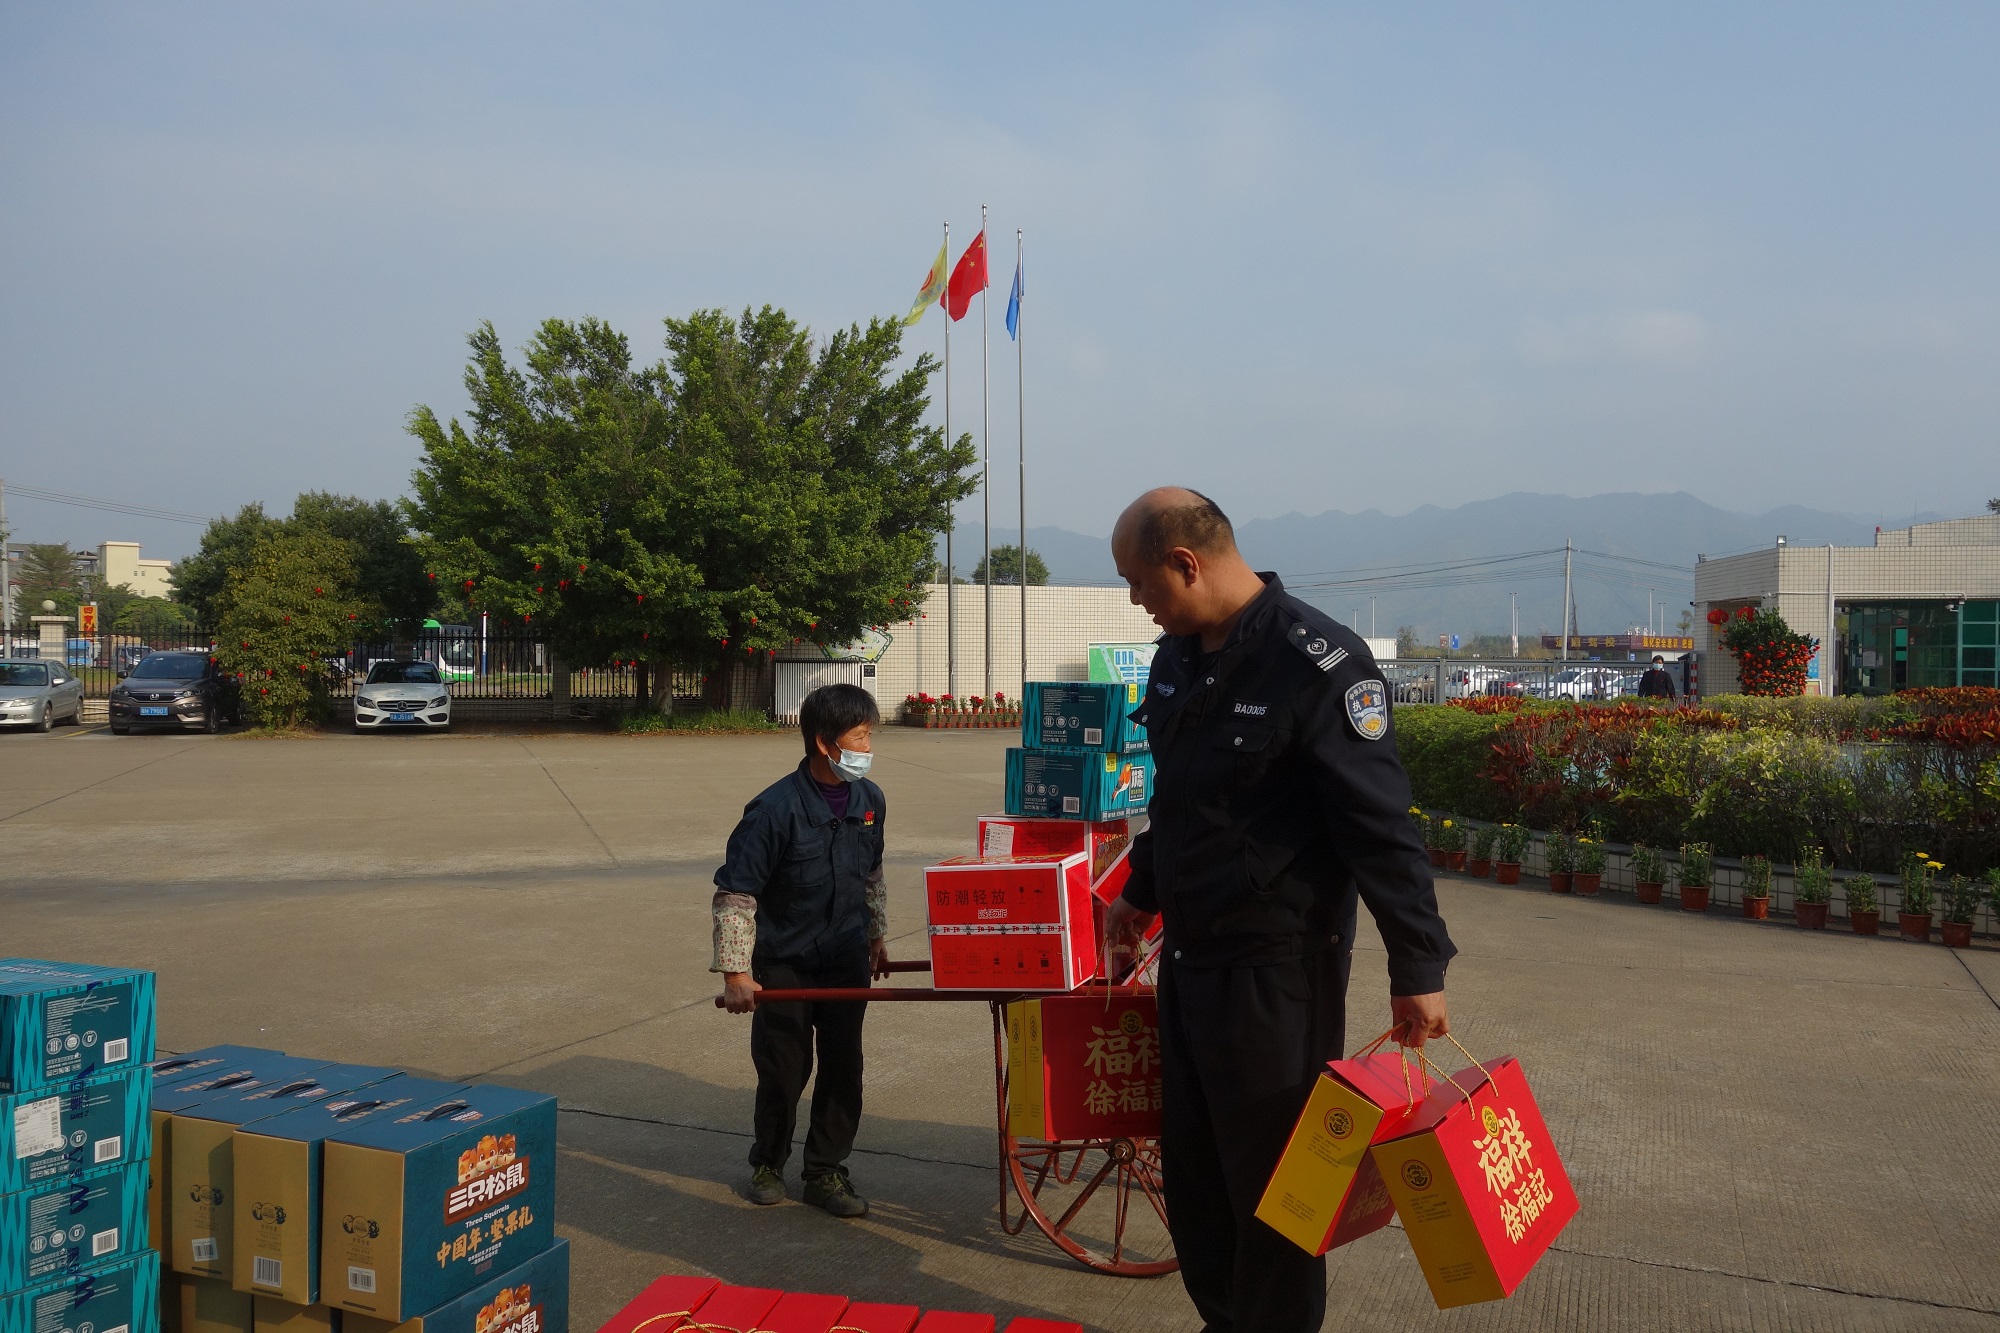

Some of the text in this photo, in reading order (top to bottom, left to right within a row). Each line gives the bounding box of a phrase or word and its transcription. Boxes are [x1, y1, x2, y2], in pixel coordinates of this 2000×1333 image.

[1233, 702, 1268, 716] BA0005
[936, 889, 1007, 906] 防潮轻放
[1472, 1107, 1533, 1198] 福祥
[448, 1162, 525, 1215] 三只松鼠
[465, 1204, 510, 1229] Three Squirrels
